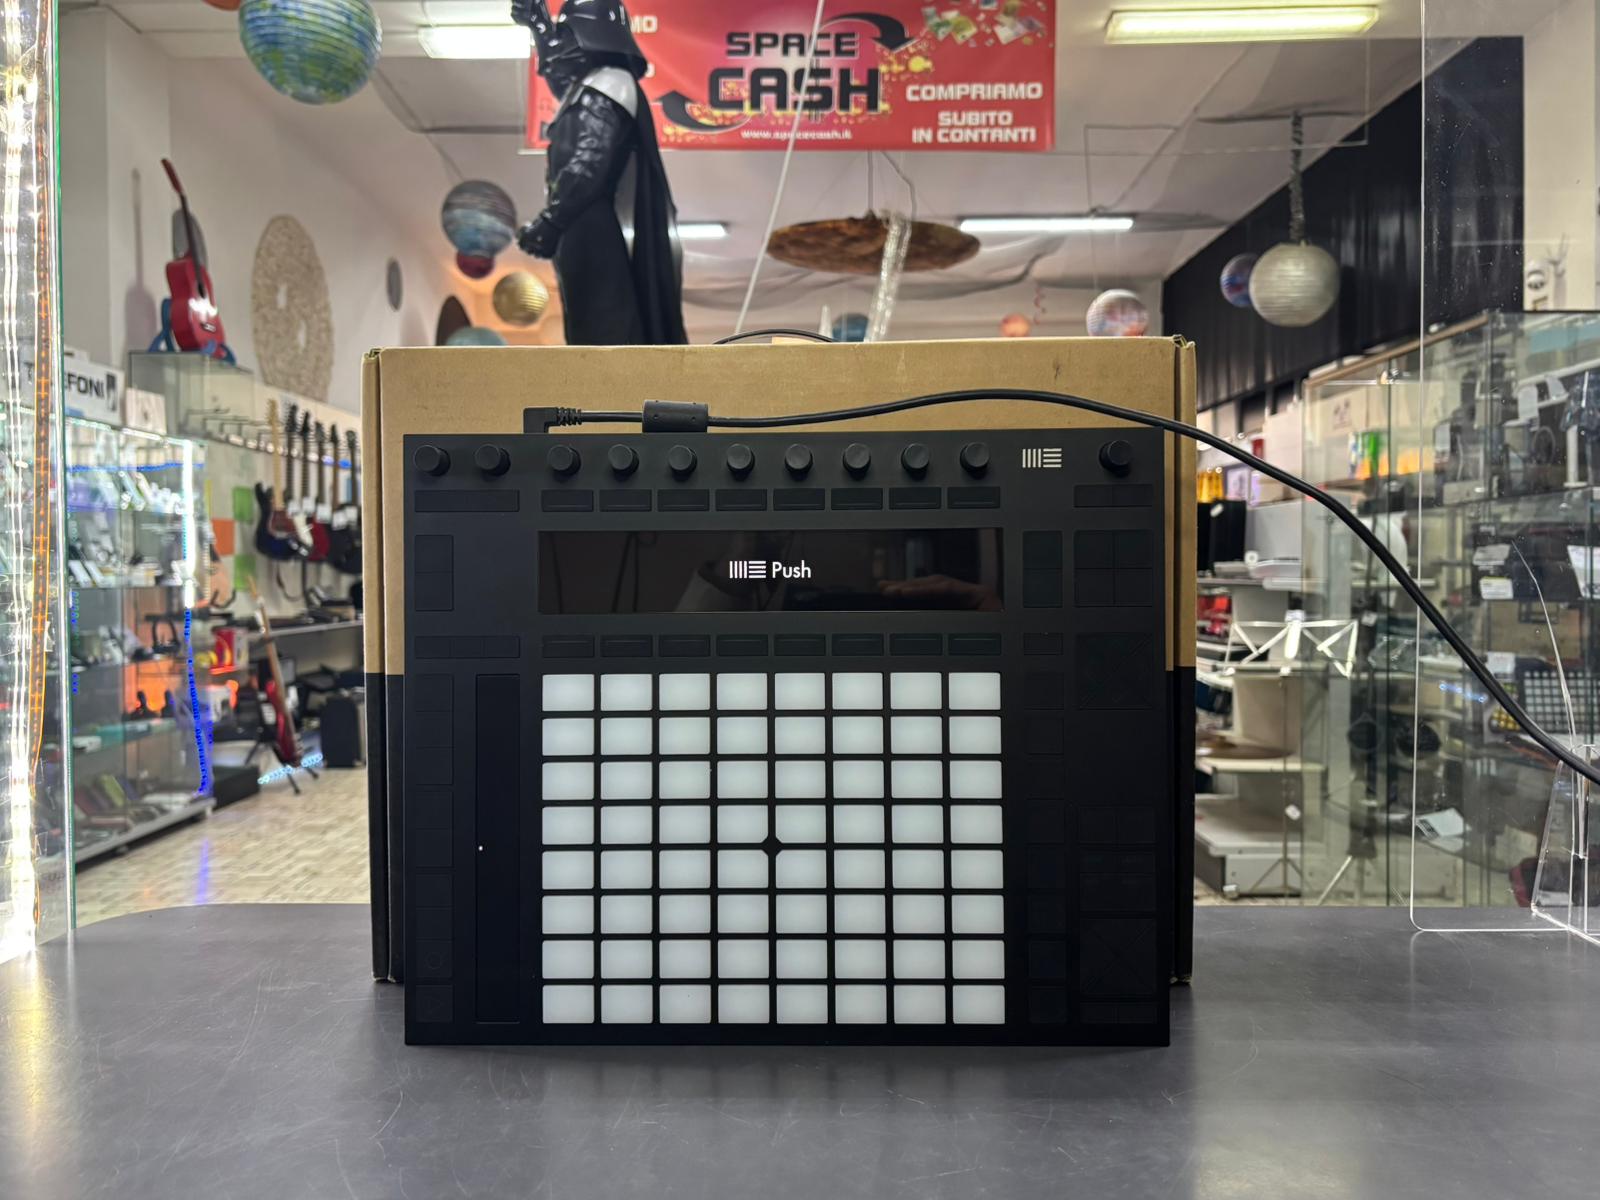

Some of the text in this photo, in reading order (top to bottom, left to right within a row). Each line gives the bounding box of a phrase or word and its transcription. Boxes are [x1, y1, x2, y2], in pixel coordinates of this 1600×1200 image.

[726, 32, 857, 57] SPACE
[906, 82, 1043, 101] COMPRIAMO
[938, 111, 1013, 126] SUBITO
[911, 127, 1037, 143] IN CONTANTI
[772, 559, 811, 578] Push
